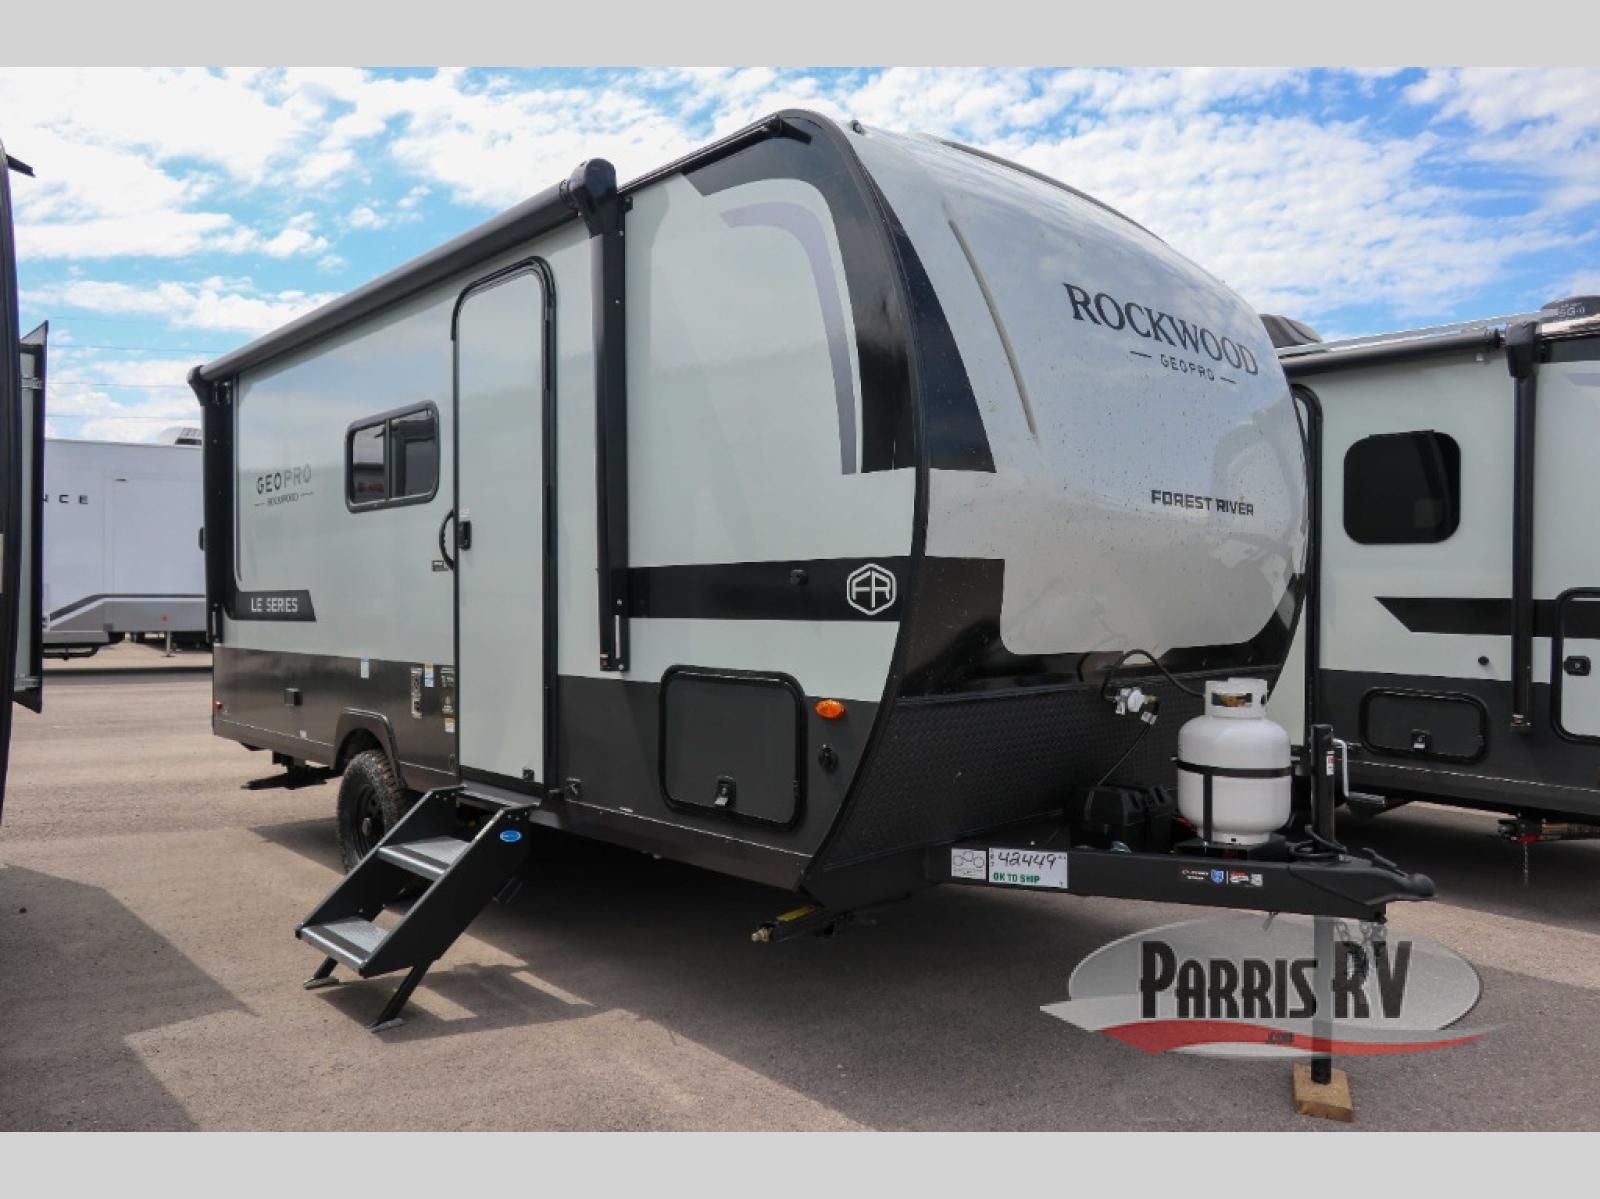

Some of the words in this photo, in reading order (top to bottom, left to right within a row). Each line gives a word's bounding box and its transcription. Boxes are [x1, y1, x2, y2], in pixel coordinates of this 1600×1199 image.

[1063, 282, 1259, 376] ROCKWOOD
[1160, 353, 1215, 382] GEOPRO
[256, 463, 312, 495] GEOPRO
[1151, 489, 1213, 511] FOREST
[1215, 497, 1254, 516] RIVER
[251, 597, 262, 612] LE
[266, 597, 298, 612] SERIES
[998, 851, 1057, 870] 42449
[993, 872, 1006, 881] OK
[1007, 873, 1018, 883] TO
[1020, 874, 1041, 884] SHIP
